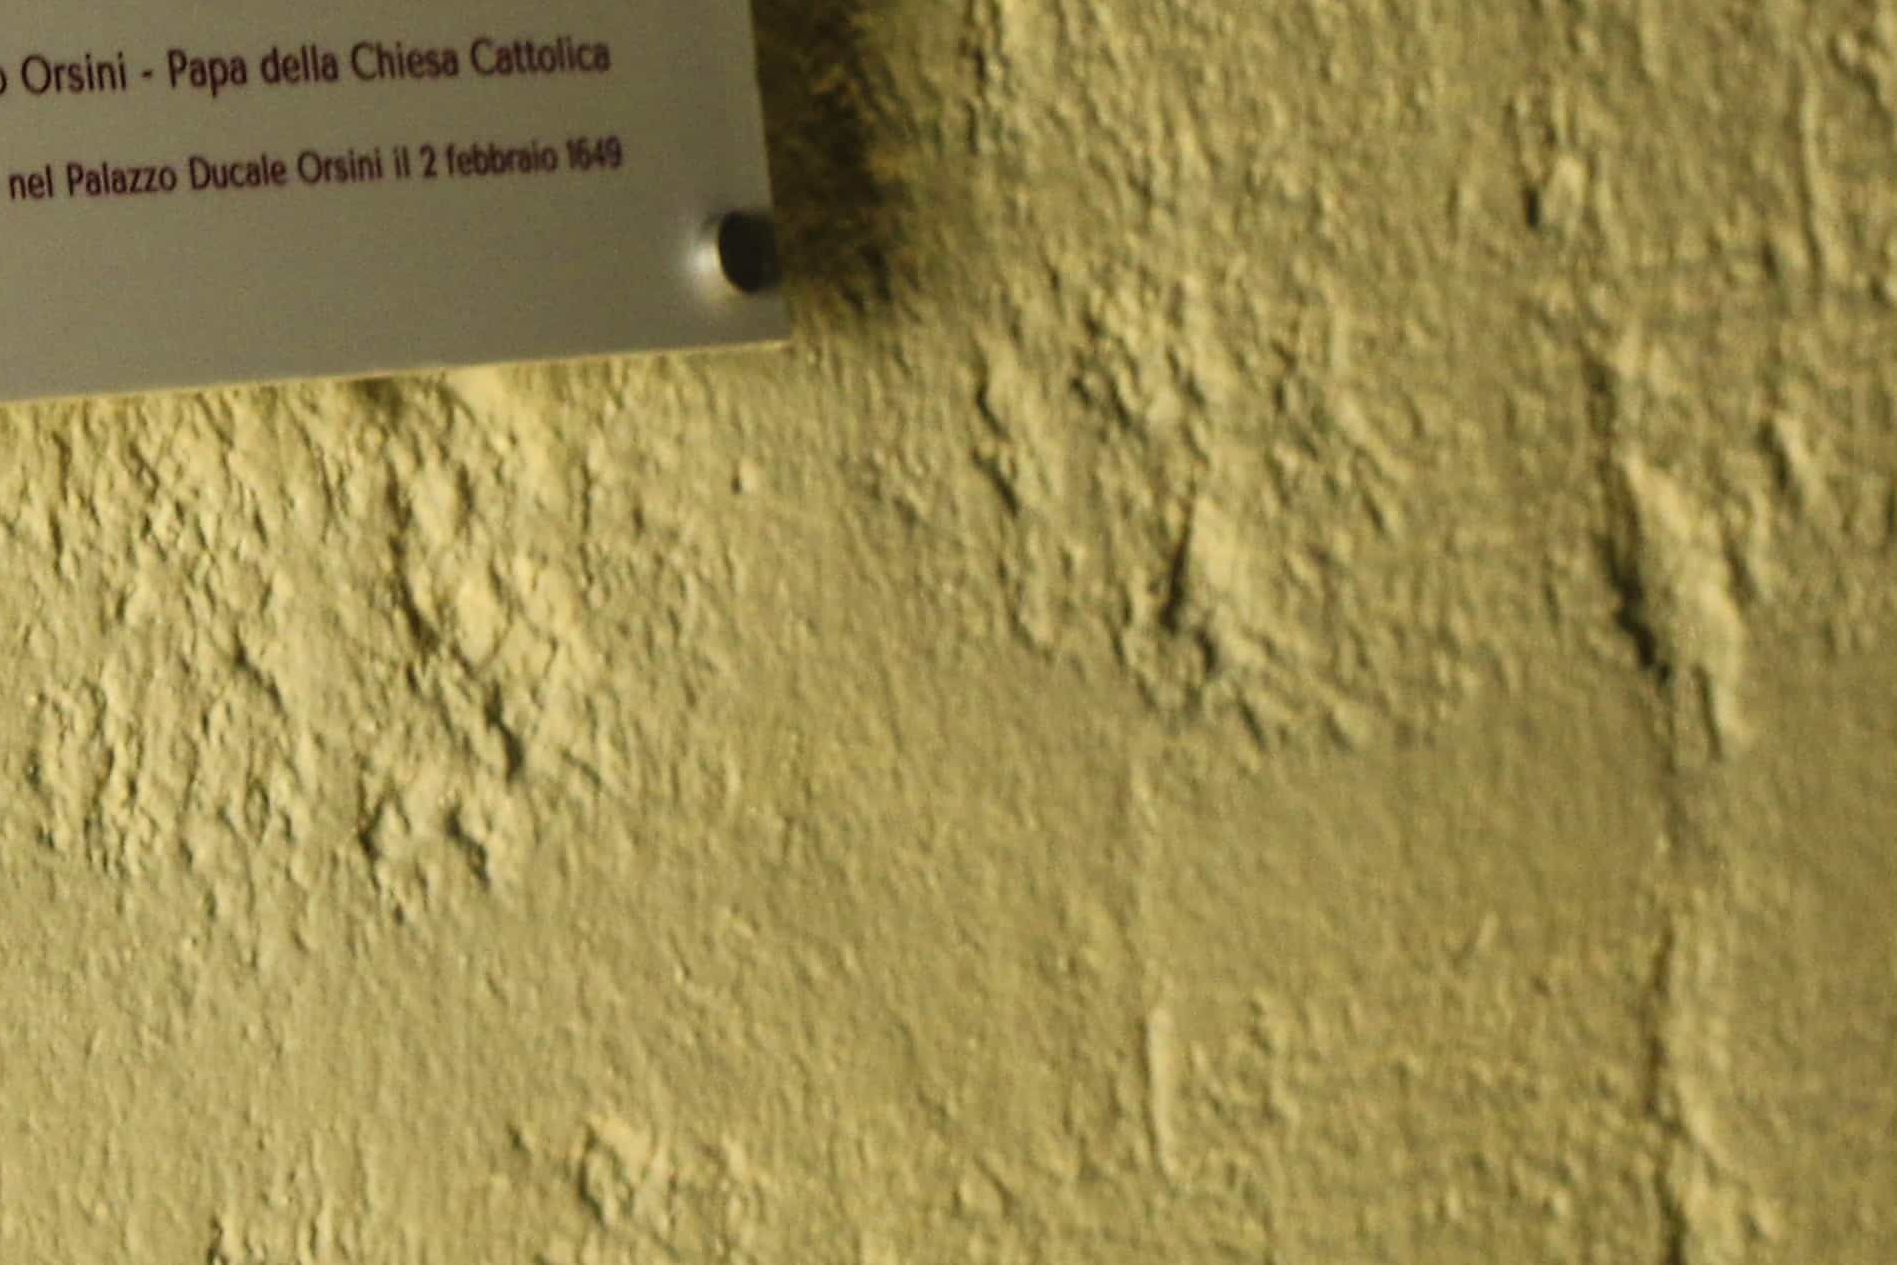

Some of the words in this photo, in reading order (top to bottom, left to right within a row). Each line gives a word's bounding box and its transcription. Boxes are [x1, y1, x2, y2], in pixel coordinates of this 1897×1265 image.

[20, 51, 128, 95] Orsini
[167, 48, 247, 98] Papa
[260, 44, 340, 84] della
[350, 41, 459, 81] Chiesa
[469, 35, 612, 76] Cattolica
[9, 165, 52, 201] nel
[66, 161, 177, 198] Palazzo
[189, 153, 287, 191] Ducale
[297, 146, 383, 184] Orsini
[393, 145, 411, 178] il
[420, 148, 438, 179] 2
[446, 140, 558, 176] febbraio
[565, 135, 624, 171] 1649
